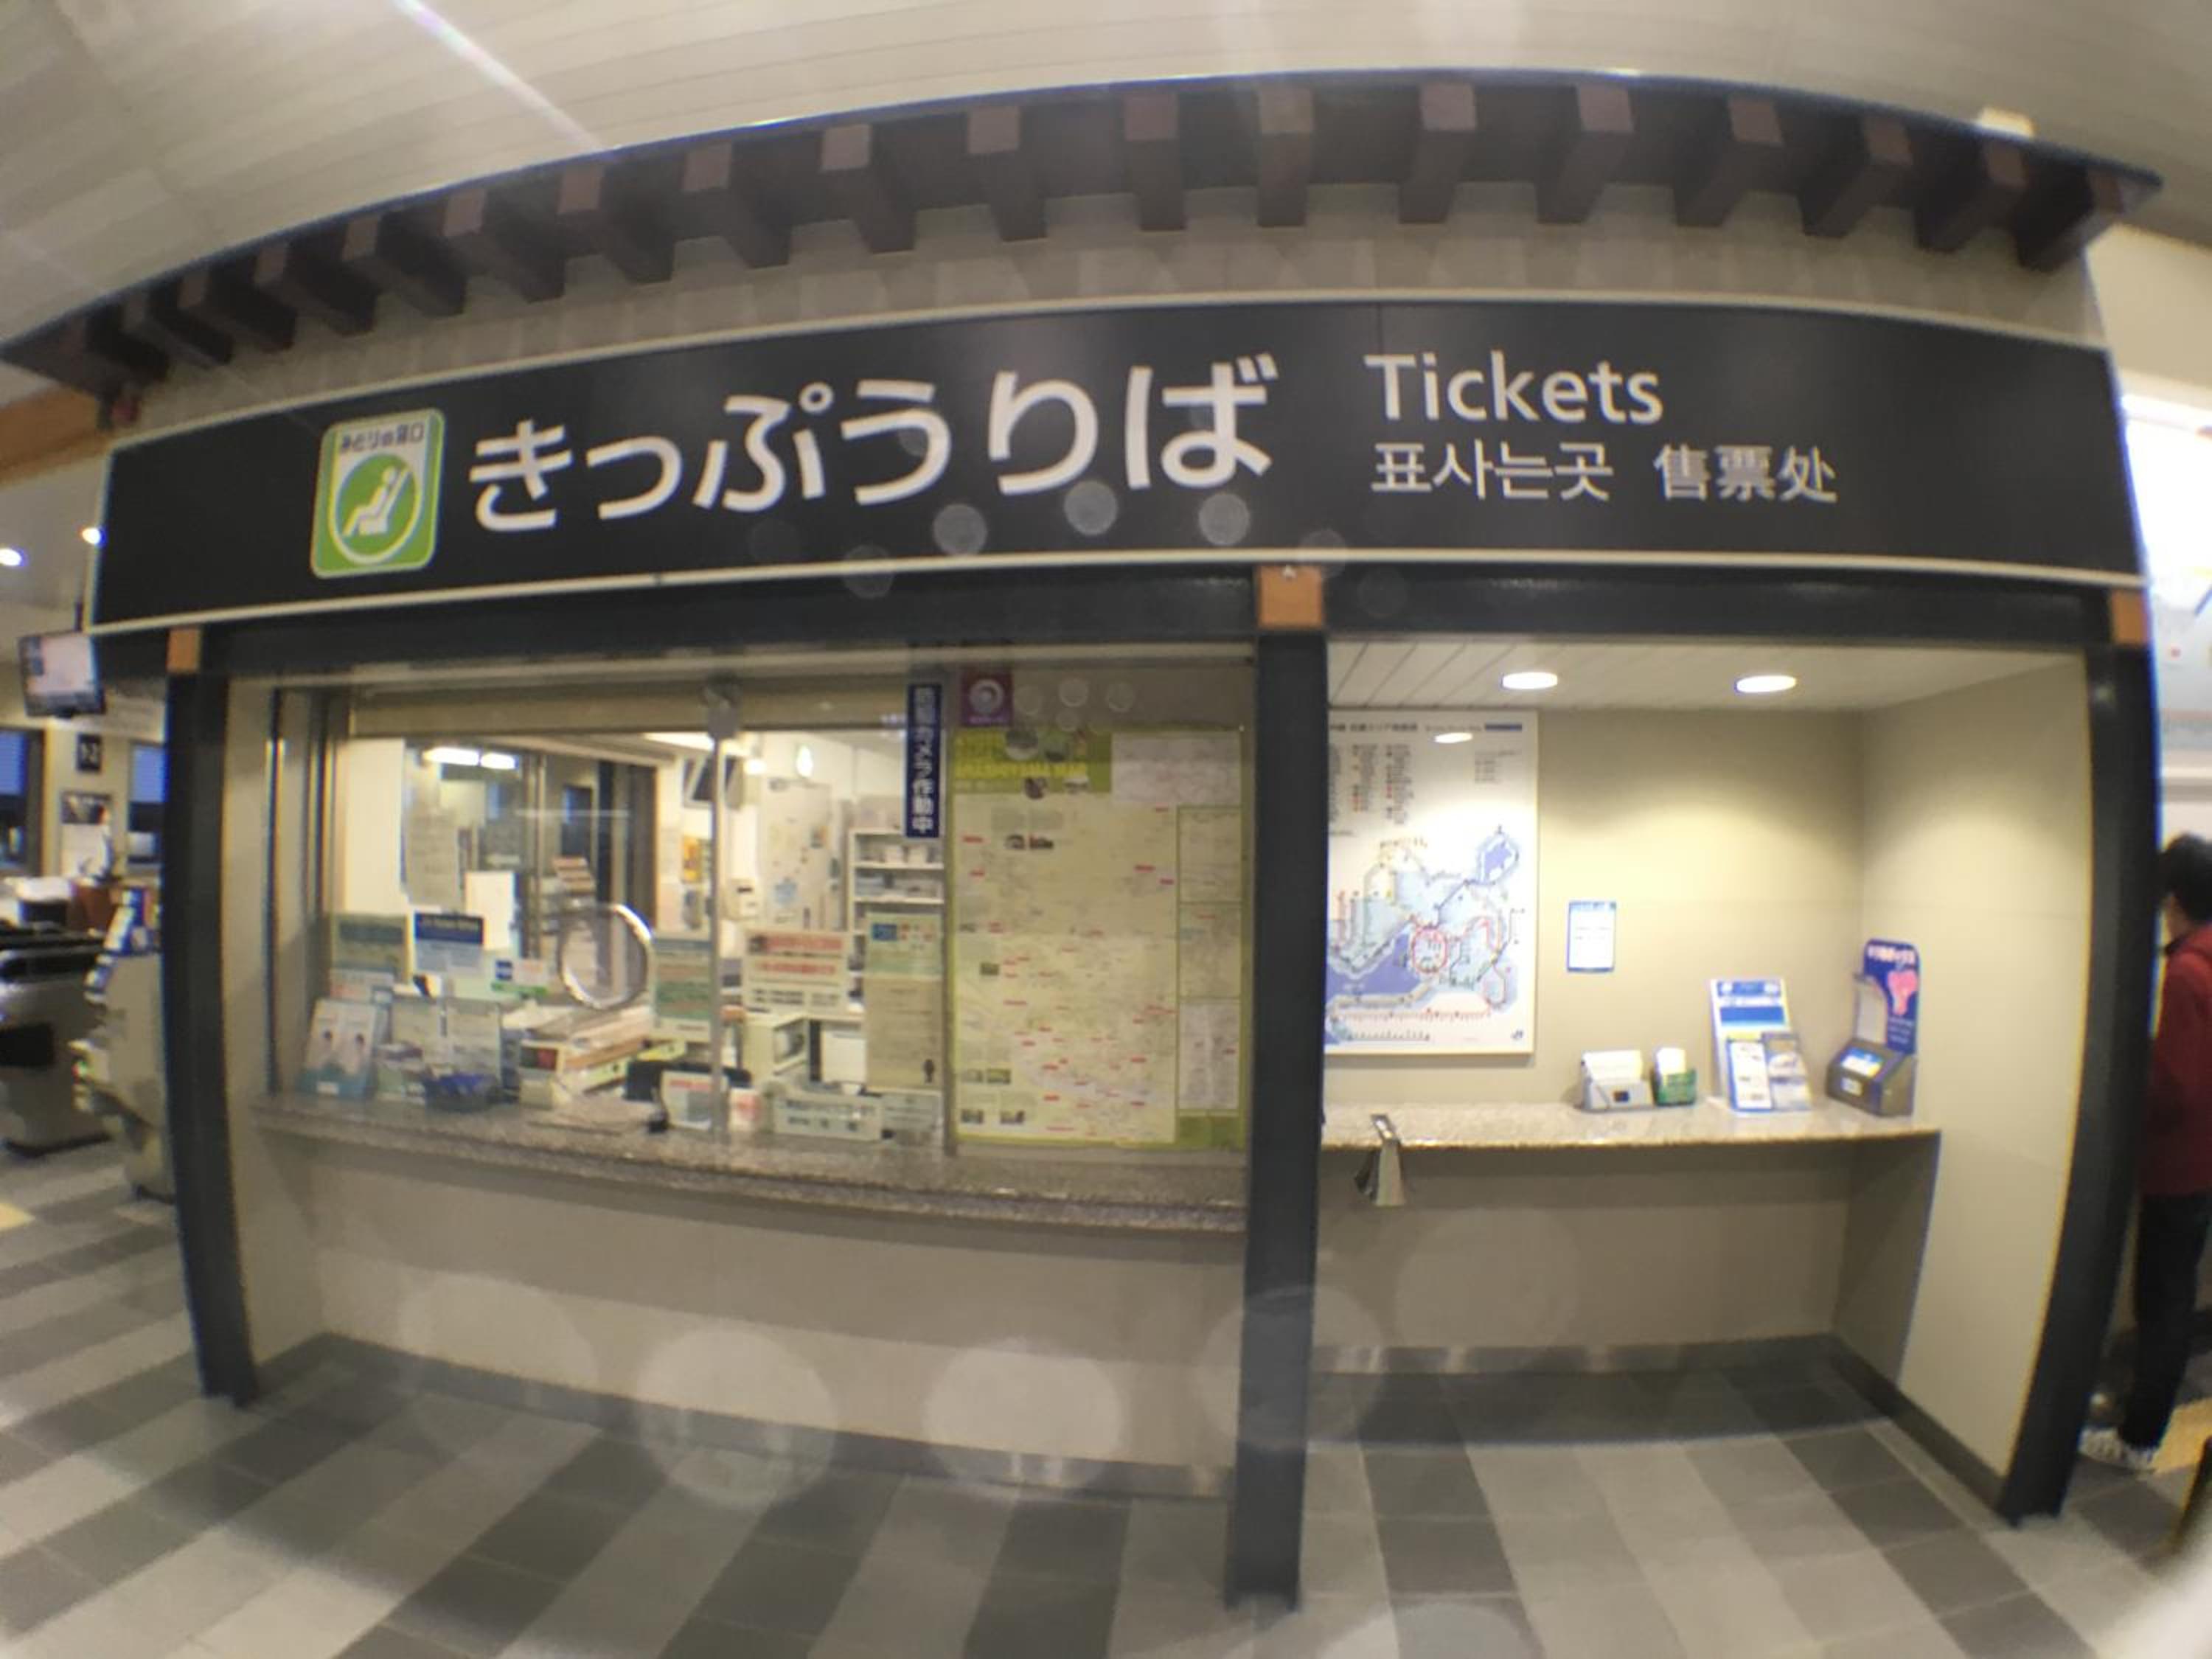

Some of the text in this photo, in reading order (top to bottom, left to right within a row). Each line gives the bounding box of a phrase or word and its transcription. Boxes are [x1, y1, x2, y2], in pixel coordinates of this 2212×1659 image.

[1363, 350, 1664, 425] Tickets
[469, 352, 1279, 532] きっぷうりば
[1371, 439, 1614, 501] 표사는곳
[1653, 444, 1839, 503] 售票处
